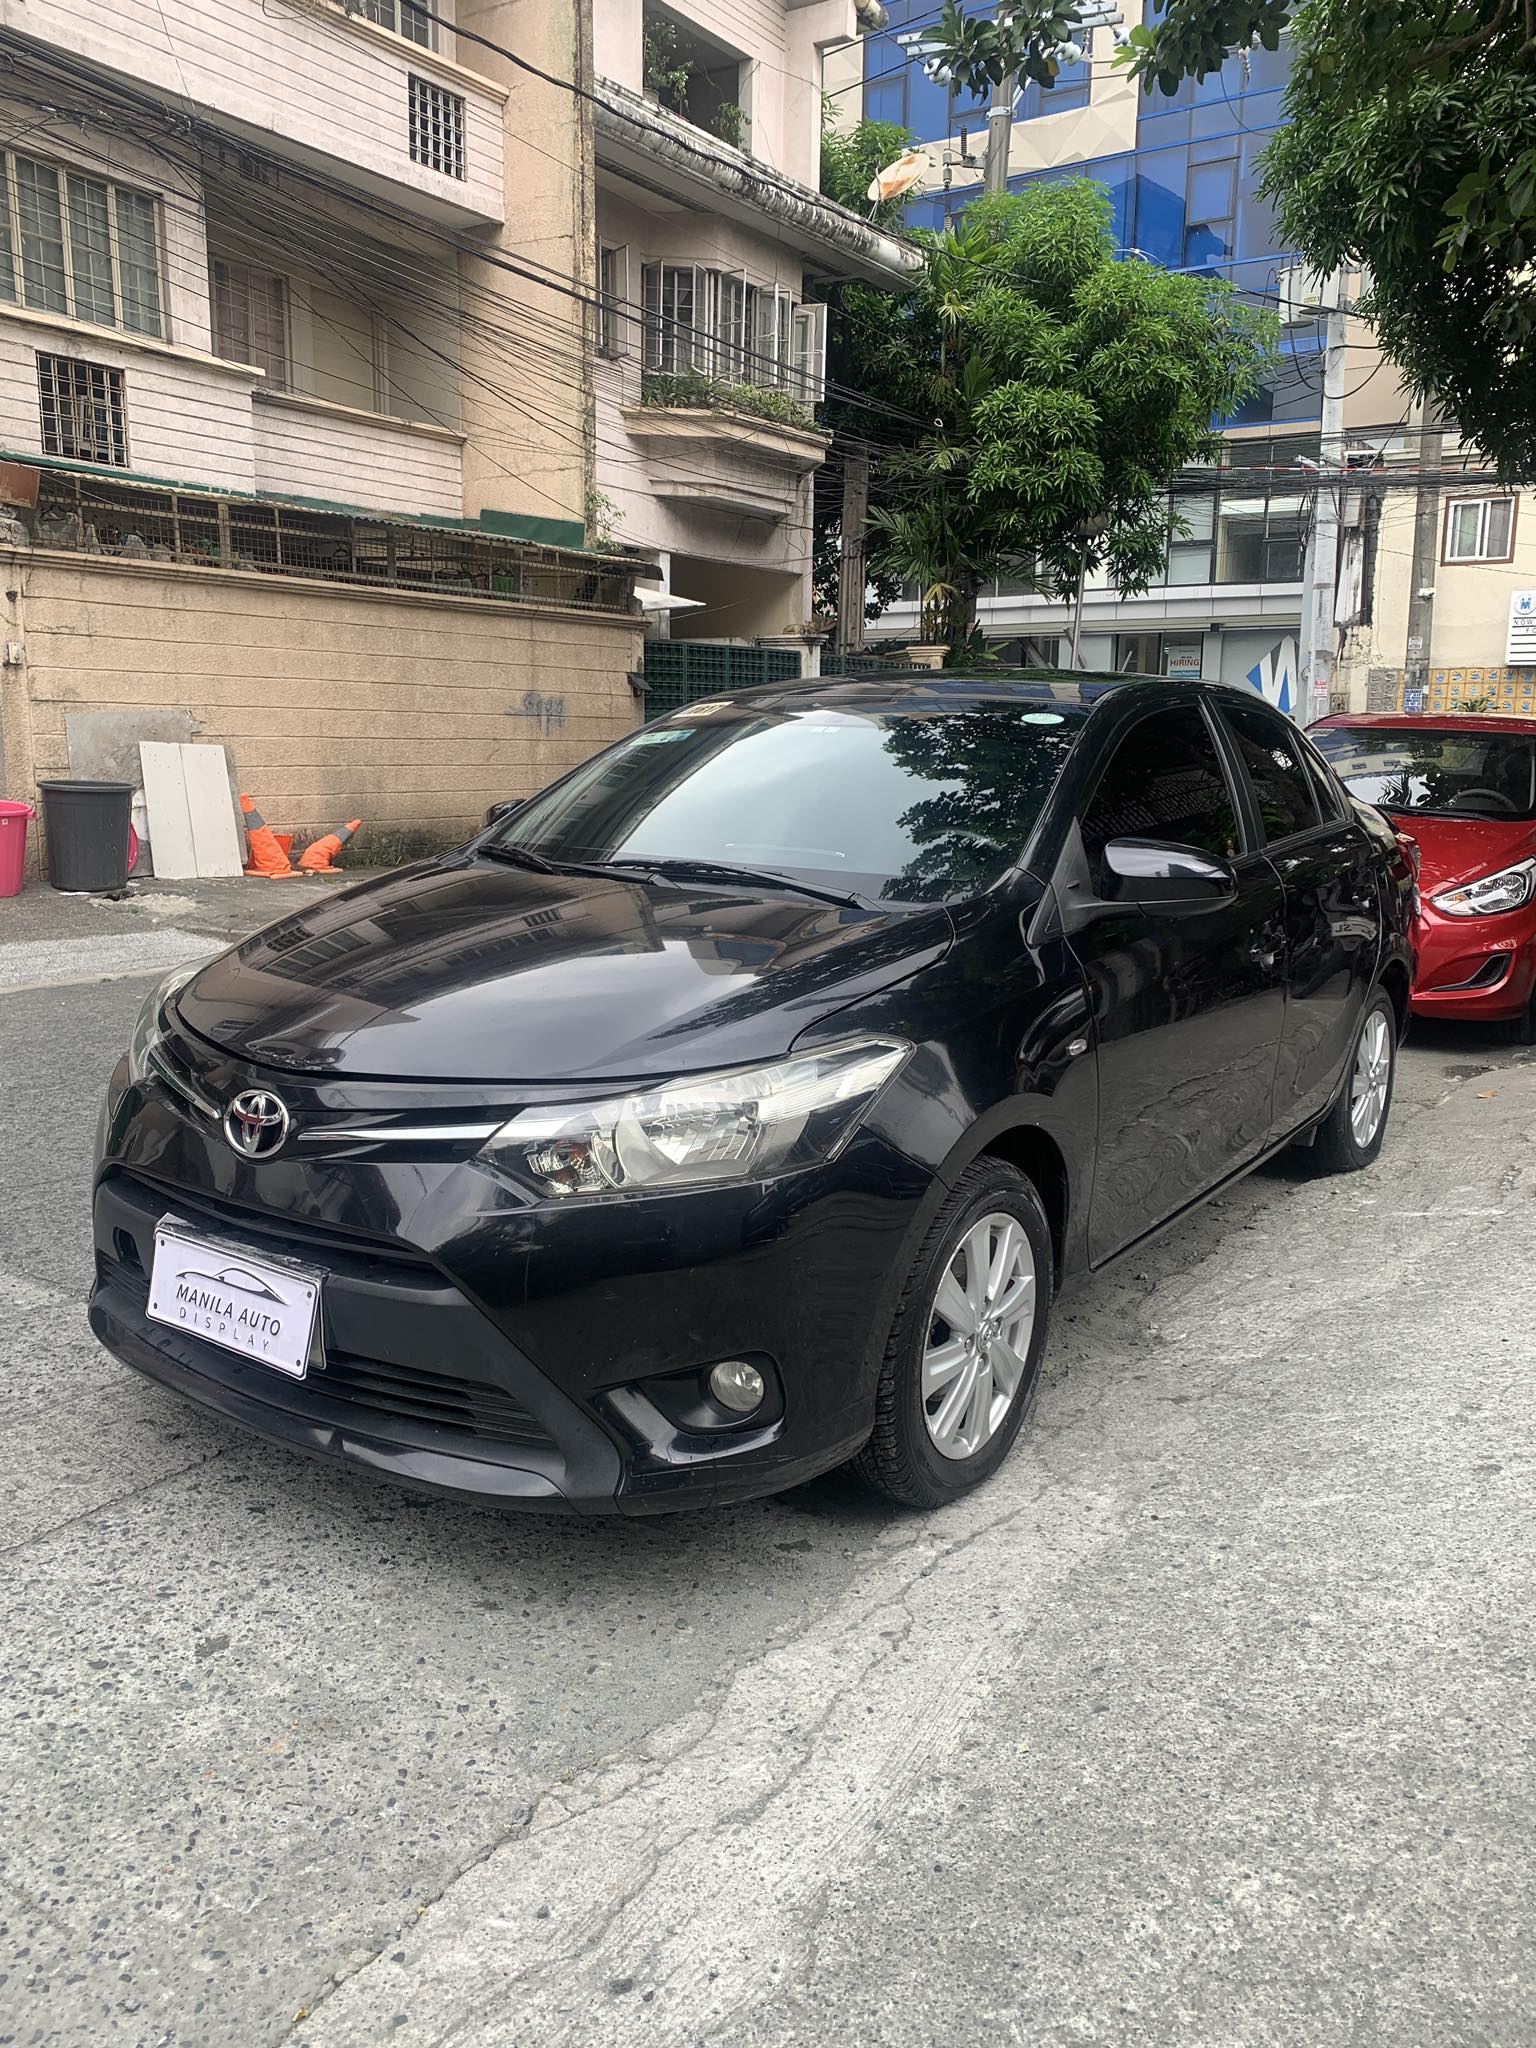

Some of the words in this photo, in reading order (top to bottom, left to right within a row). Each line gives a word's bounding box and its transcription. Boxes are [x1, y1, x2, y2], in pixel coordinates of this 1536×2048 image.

[176, 1284, 233, 1319] MANILA
[238, 1308, 281, 1336] AUTO
[179, 1307, 269, 1351] DISPLAY
